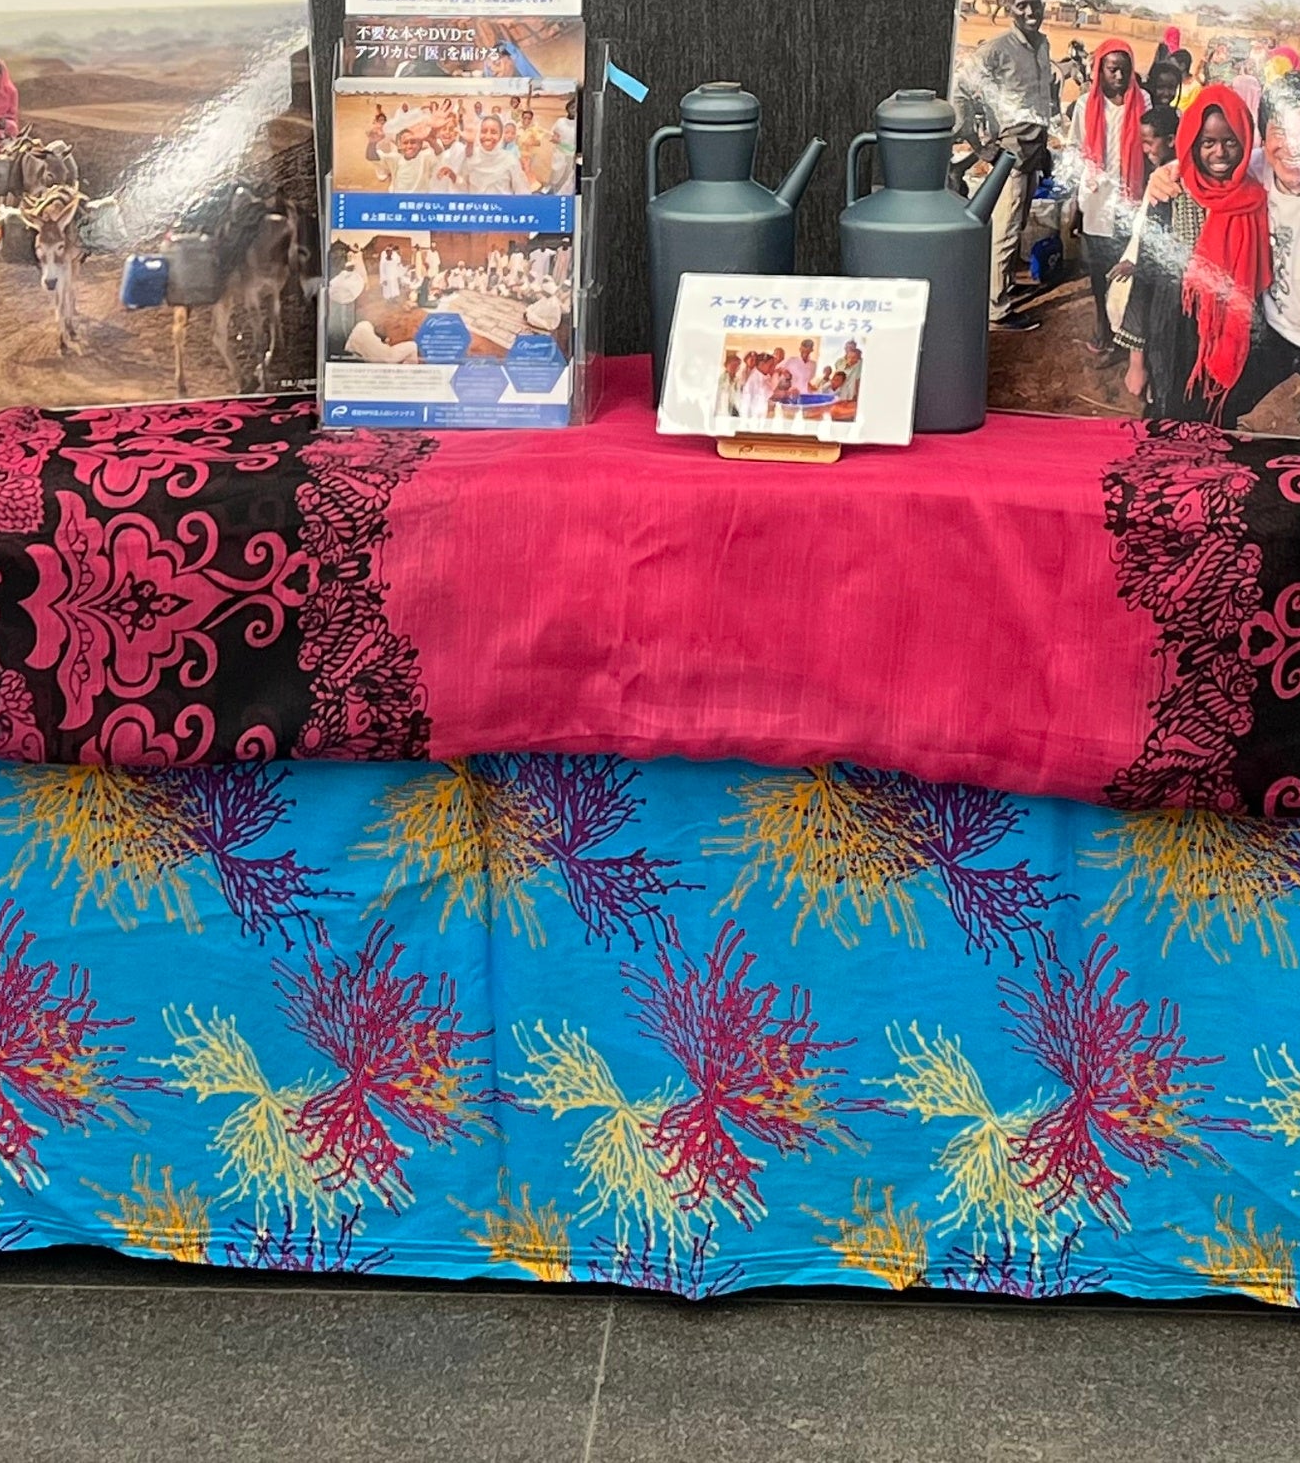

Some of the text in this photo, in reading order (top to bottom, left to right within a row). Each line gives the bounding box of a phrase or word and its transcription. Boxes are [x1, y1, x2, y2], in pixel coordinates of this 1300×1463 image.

[356, 25, 476, 41] 不要な本やDVDで
[355, 45, 500, 61] アフリカに「医」を届ける
[710, 296, 893, 313] スーダンで、手洗いの際に
[723, 314, 874, 333] 使われているじょうろ
